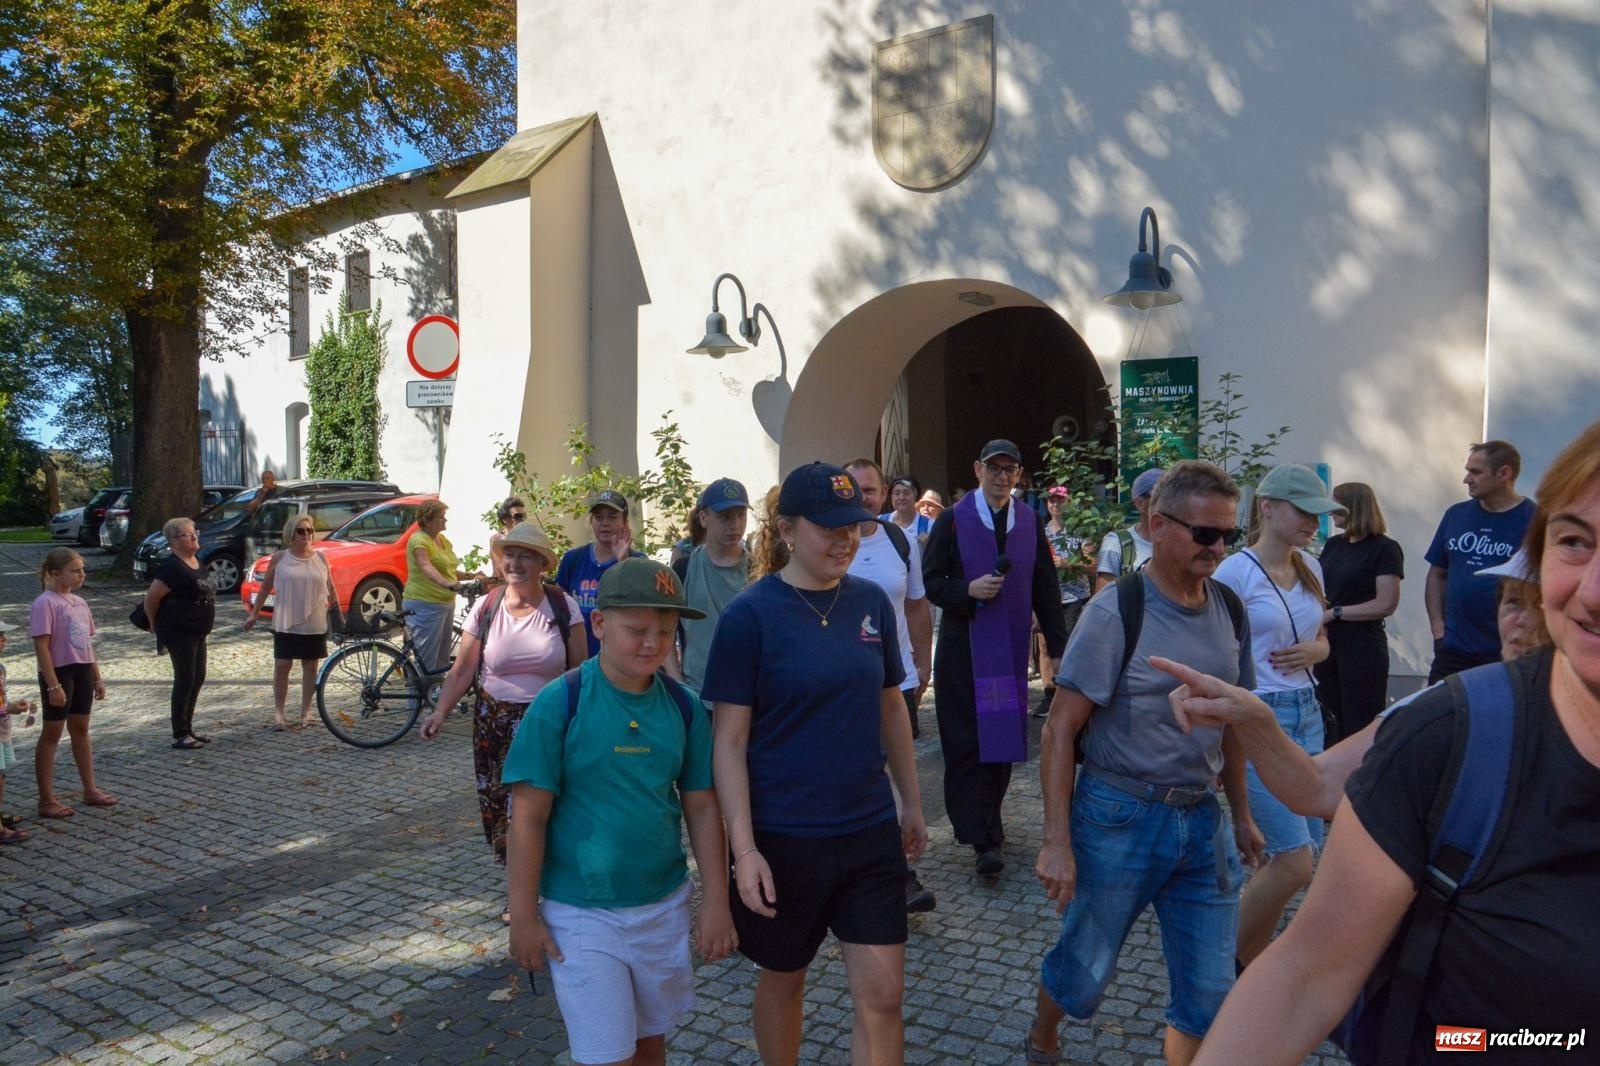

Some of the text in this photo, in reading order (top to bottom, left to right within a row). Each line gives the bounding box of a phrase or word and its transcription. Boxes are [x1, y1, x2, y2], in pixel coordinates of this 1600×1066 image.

[1125, 385, 1194, 397] MASZYNOWNIA
[1448, 532, 1514, 557] s.Oliver
[580, 579, 600, 591] ne
[572, 589, 599, 608] bala
